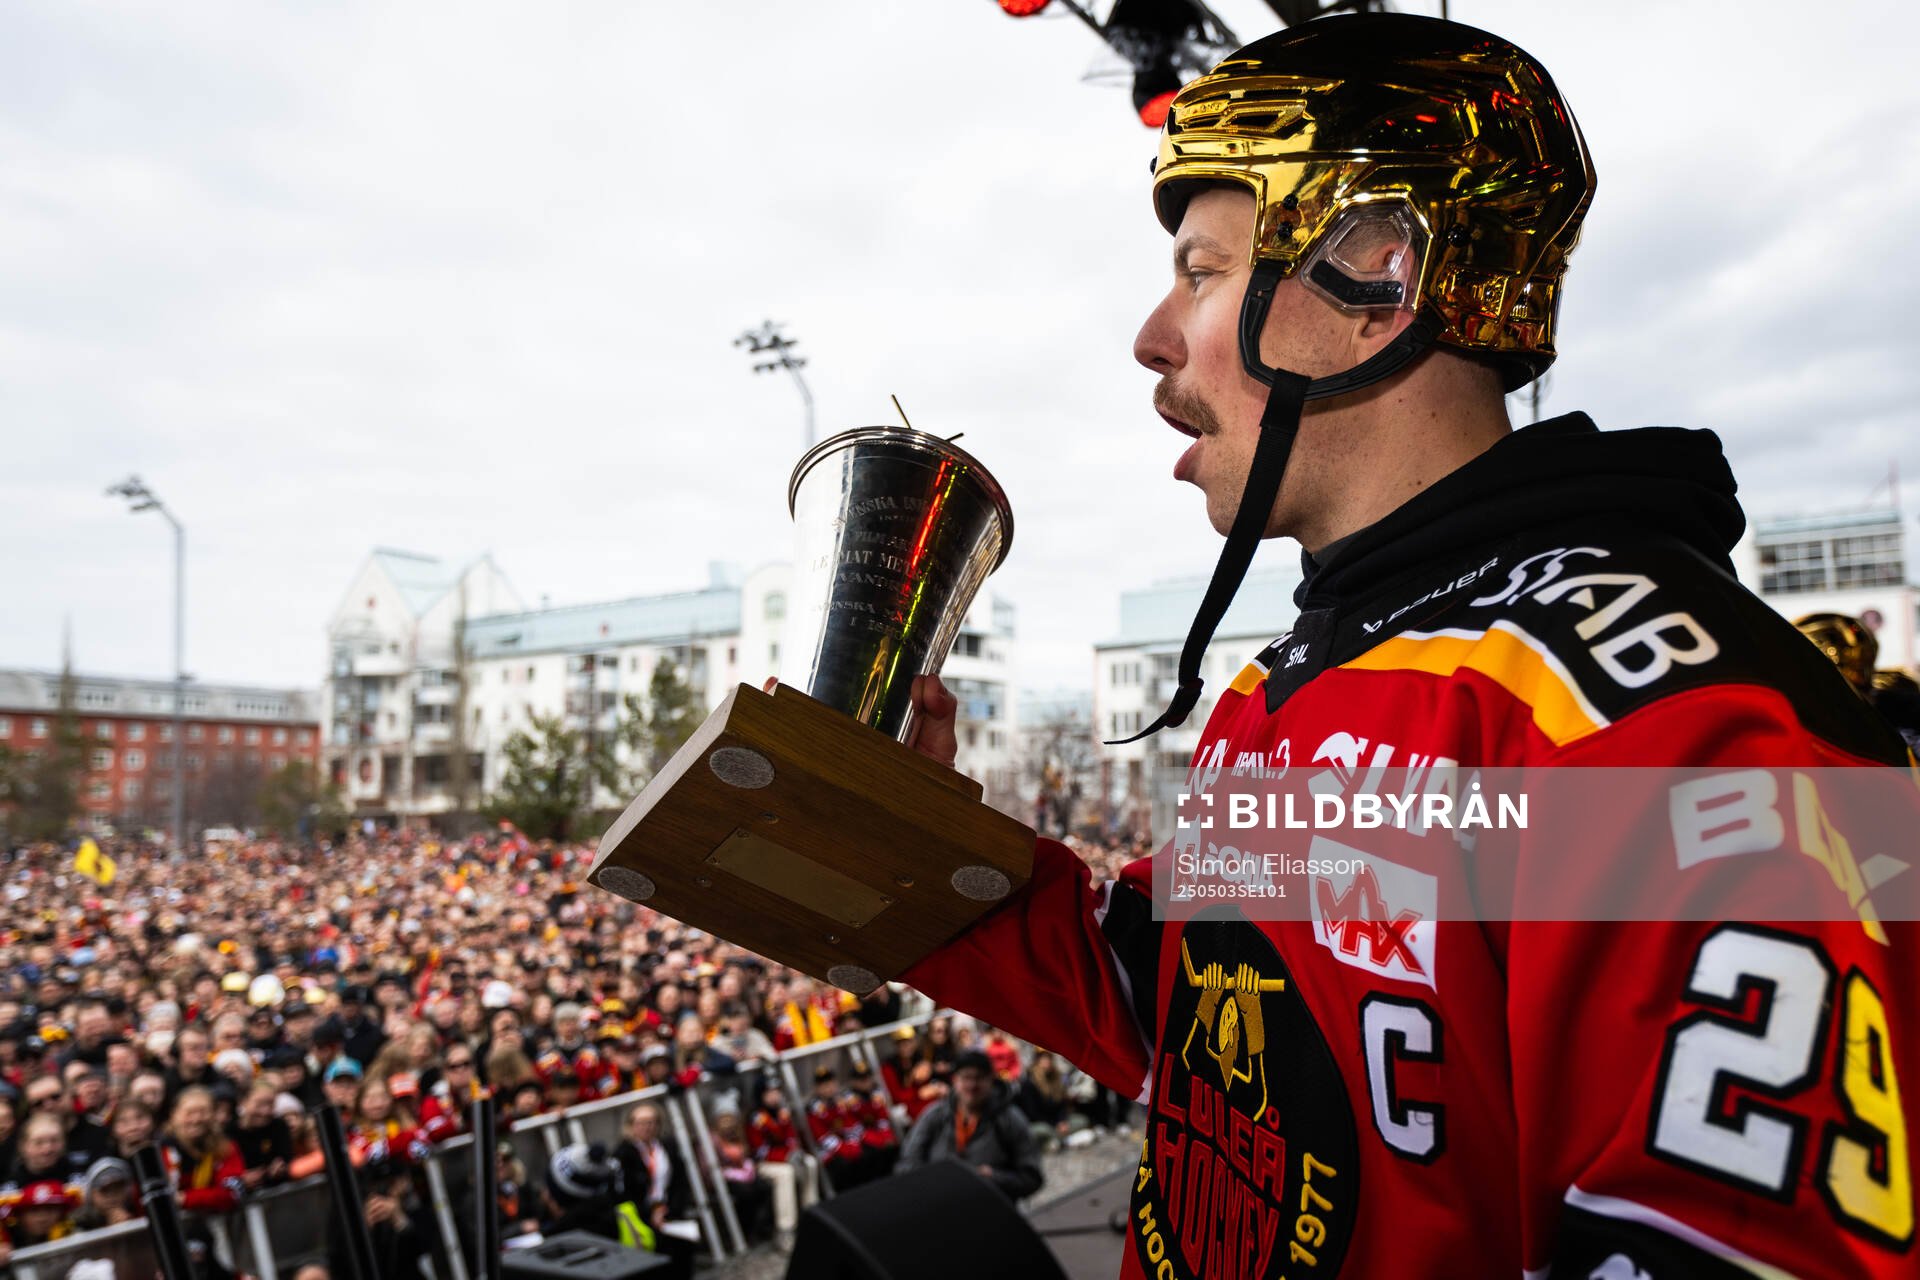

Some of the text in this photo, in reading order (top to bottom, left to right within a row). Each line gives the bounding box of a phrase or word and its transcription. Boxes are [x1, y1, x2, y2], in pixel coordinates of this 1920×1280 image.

[1284, 643, 1310, 669] SHL
[1469, 546, 1720, 689] SSAB
[1315, 864, 1426, 977] MAX
[1157, 1052, 1286, 1203] LULEÅ
[1361, 994, 1442, 1162] C
[1649, 924, 1914, 1248] 29
[1289, 1152, 1337, 1267] 1977
